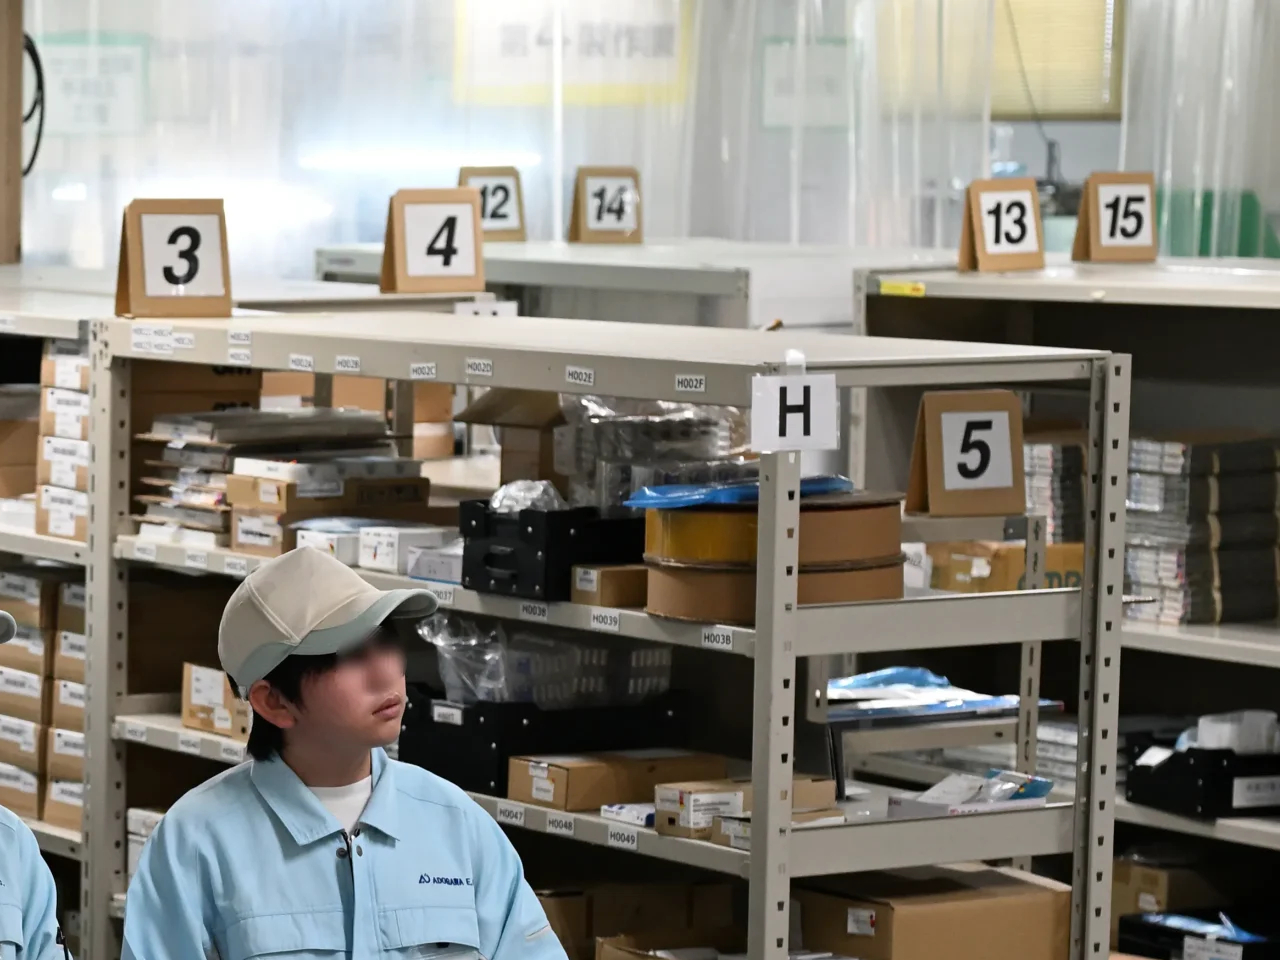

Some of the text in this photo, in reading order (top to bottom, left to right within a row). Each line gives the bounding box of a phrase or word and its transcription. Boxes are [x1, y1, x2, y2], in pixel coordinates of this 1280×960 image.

[480, 184, 511, 220] 12
[592, 184, 628, 223] 14
[986, 200, 1028, 245] 13
[1104, 195, 1145, 240] 15
[426, 215, 459, 267] 4
[162, 226, 202, 286] 3
[567, 369, 593, 384] H002E
[676, 377, 704, 390] H002F
[778, 385, 812, 438] H
[956, 420, 994, 479] 5
[522, 604, 548, 618] H0038
[592, 613, 618, 627] H0039
[703, 631, 732, 646] H003B
[499, 808, 523, 821] H0047
[548, 818, 573, 831] H0048
[609, 831, 636, 845] H0049
